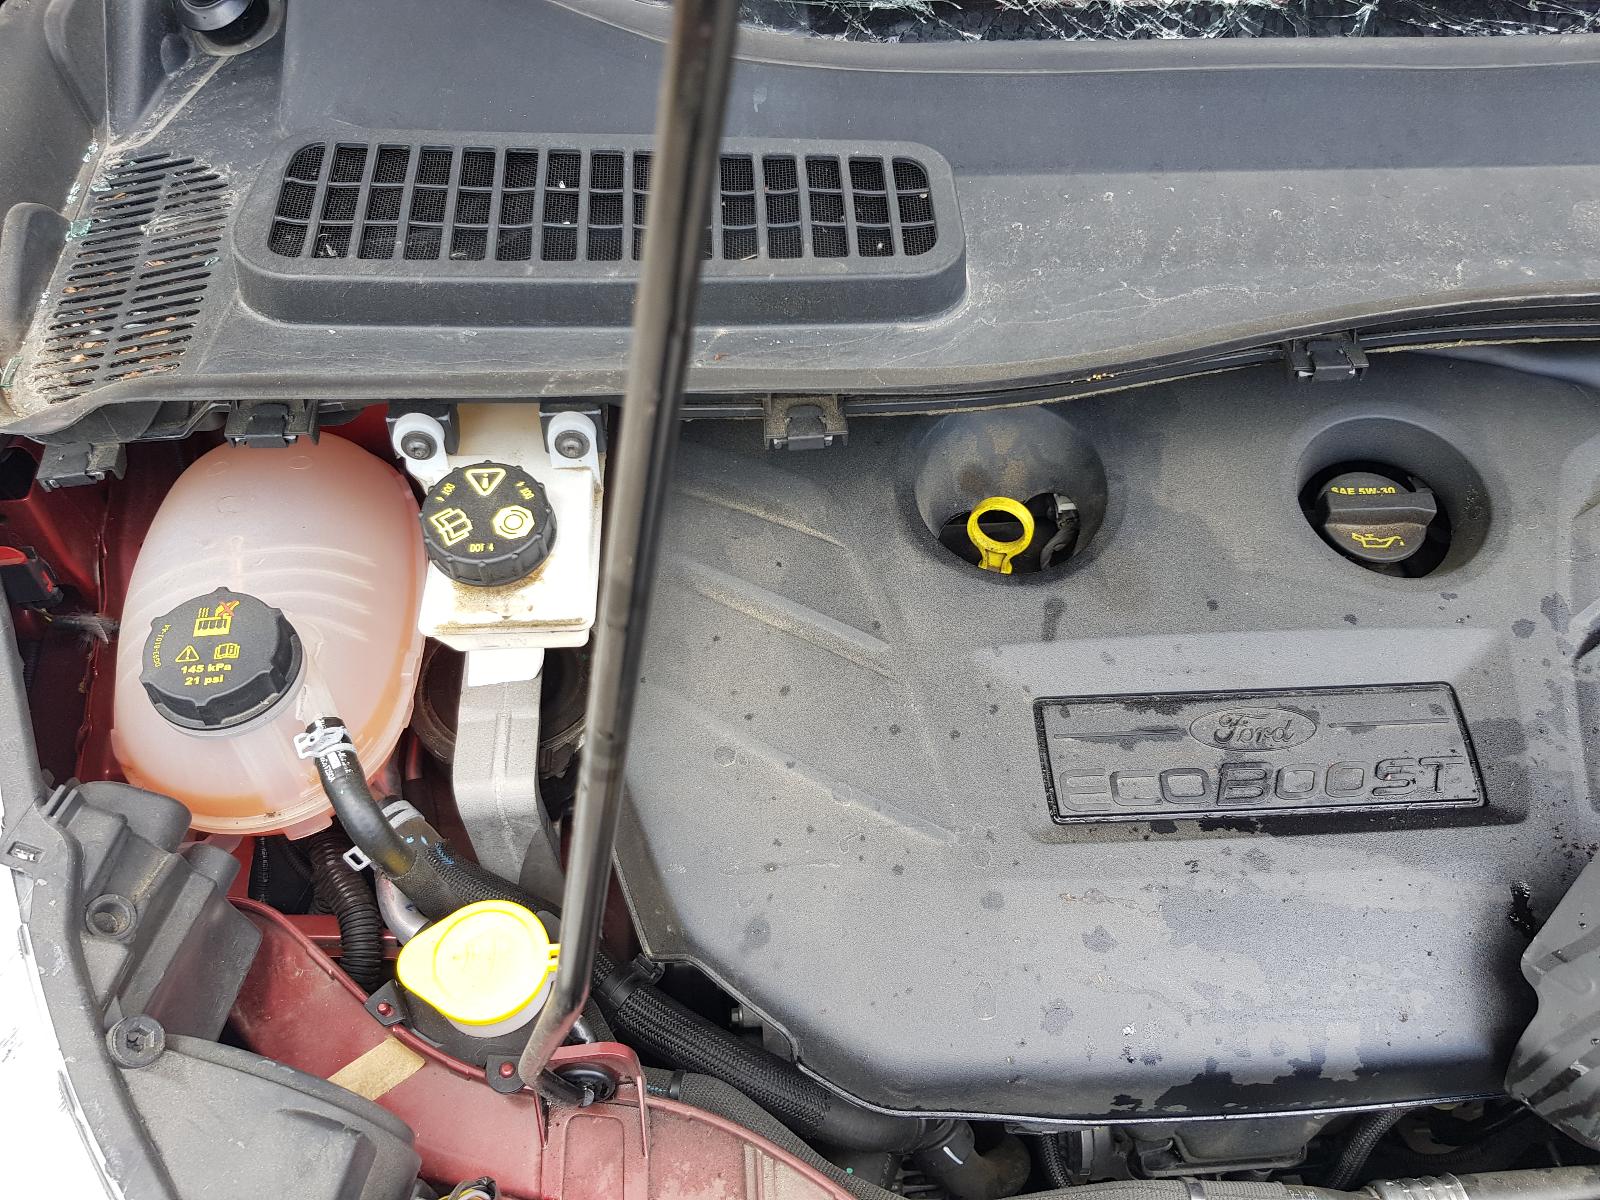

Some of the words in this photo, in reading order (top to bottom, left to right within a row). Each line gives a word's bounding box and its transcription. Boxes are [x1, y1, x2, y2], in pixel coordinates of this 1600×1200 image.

[1330, 486, 1356, 495] SAE
[1358, 486, 1396, 495] 5W-30
[469, 543, 485, 553] DOT
[488, 542, 495, 552] 4
[180, 664, 205, 675] 145
[207, 662, 232, 673] kPa
[184, 676, 200, 686] 21
[203, 674, 224, 686] psi
[1213, 711, 1295, 744] Ford
[1059, 756, 1465, 812] ECOBOOST
